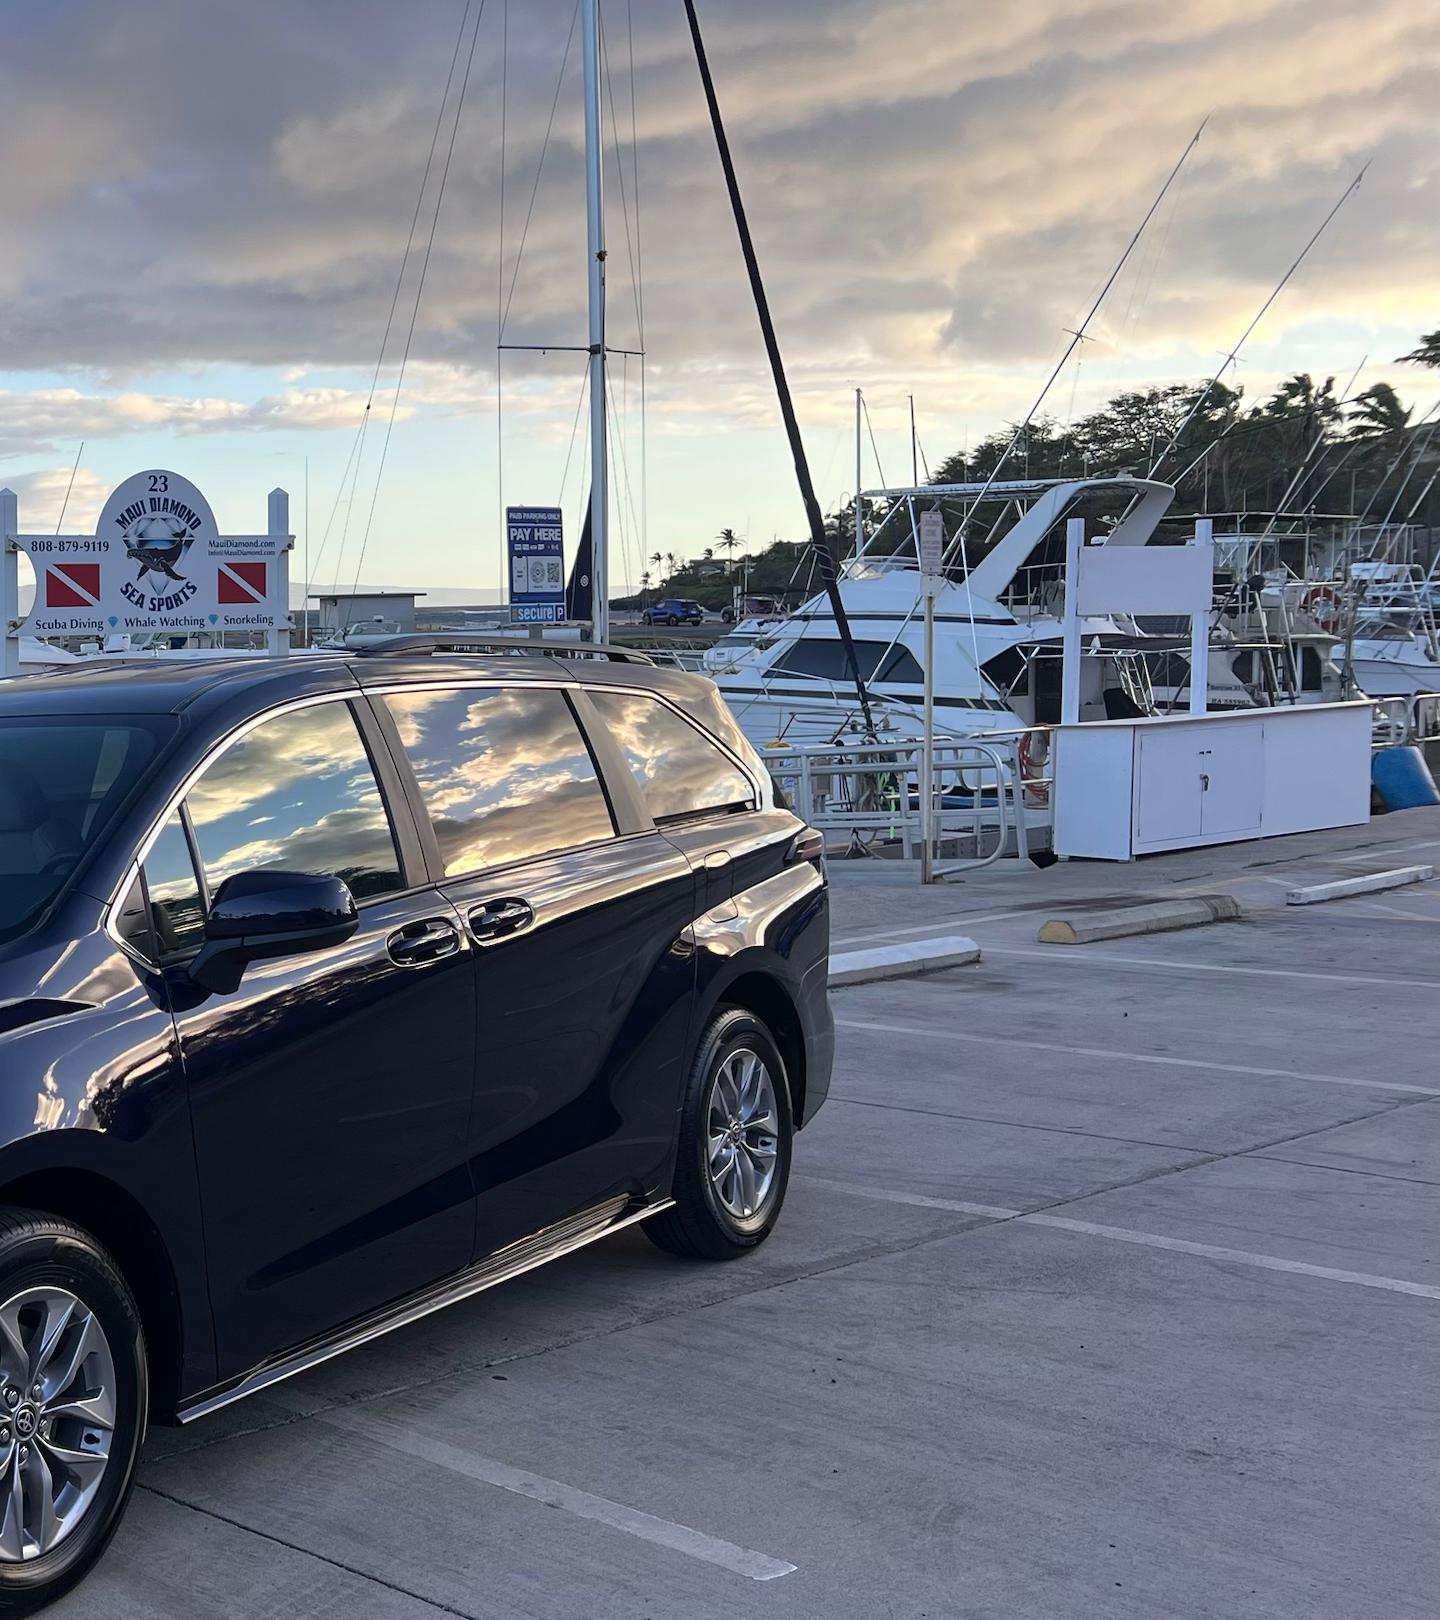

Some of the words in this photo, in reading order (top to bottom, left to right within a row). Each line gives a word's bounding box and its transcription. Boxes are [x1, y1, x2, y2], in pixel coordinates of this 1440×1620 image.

[148, 475, 168, 492] 23
[115, 500, 147, 530] MAUI
[149, 497, 202, 531] DIAMOND
[510, 528, 531, 541] PAY
[534, 528, 561, 541] HERE
[31, 540, 109, 552] 808-879-9119
[208, 540, 276, 548] MauiDiamond.com
[120, 581, 146, 609] SEA
[148, 581, 198, 612] SPORTS
[518, 606, 553, 620] secure
[35, 619, 67, 630] Scuba
[70, 618, 104, 632] Diving
[124, 616, 157, 628] Whale
[159, 616, 205, 628] Watching
[223, 614, 274, 627] Snorkeling
